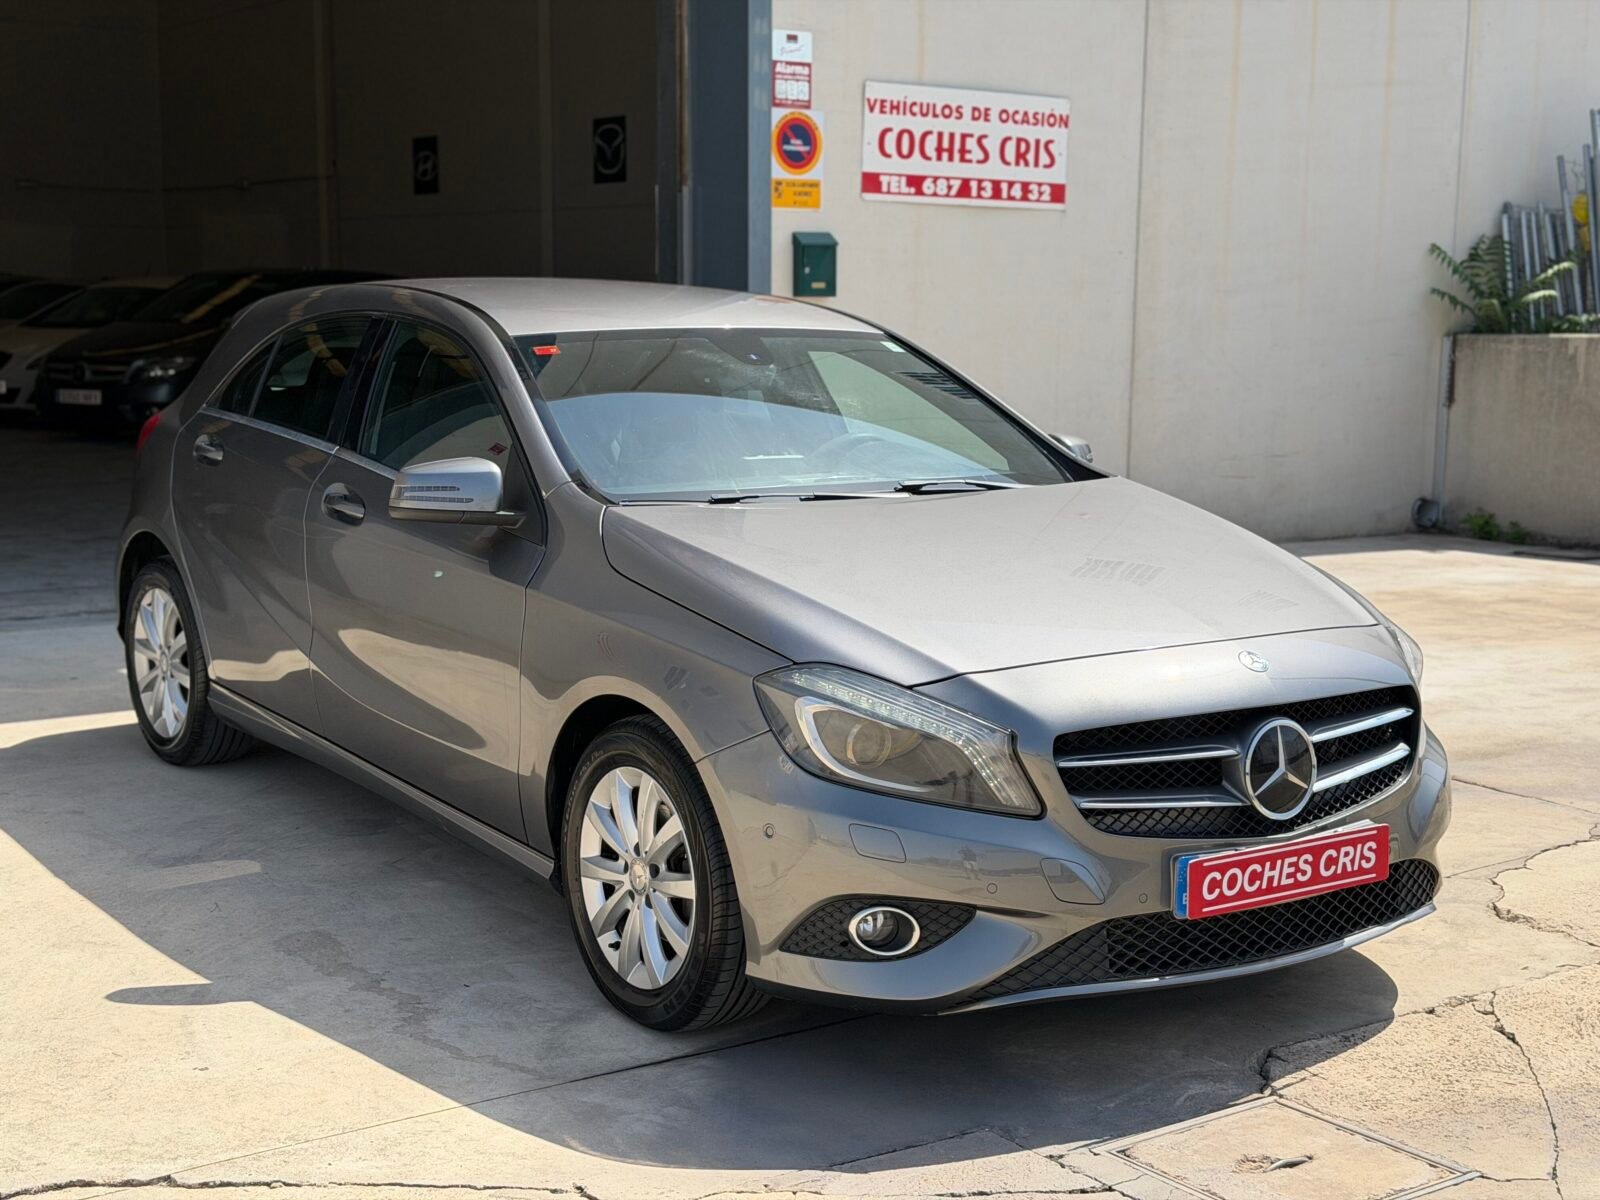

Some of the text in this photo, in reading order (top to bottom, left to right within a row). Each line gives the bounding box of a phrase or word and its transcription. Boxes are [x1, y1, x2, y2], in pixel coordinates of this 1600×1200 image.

[775, 62, 810, 76] Alarma
[866, 96, 1070, 129] VEHÍCULOS DE OCASIÓN
[878, 127, 1056, 169] COCHES CRIS
[879, 175, 1052, 201] TEL. 687 13 14 32
[1202, 841, 1377, 901] COCHES CRIS
